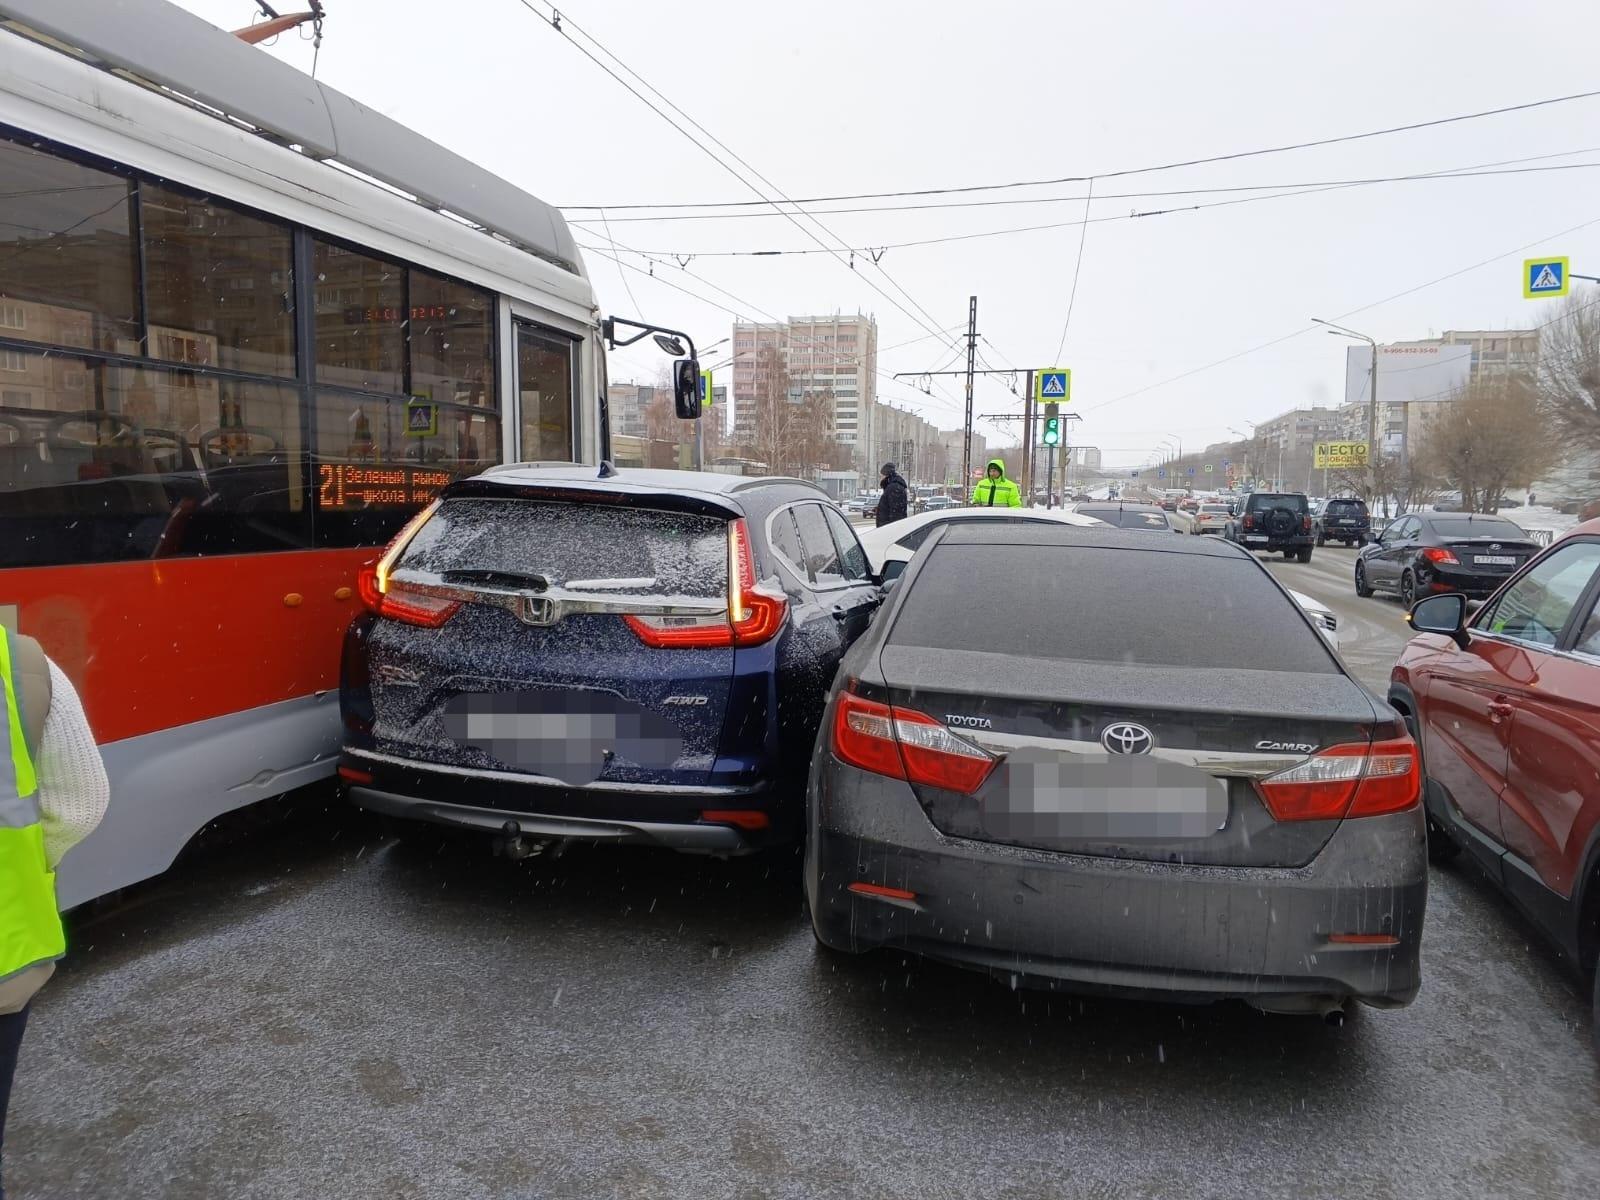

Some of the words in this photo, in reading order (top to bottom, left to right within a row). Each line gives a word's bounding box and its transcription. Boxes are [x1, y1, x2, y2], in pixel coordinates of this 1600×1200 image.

[1318, 444, 1366, 456] МЕСТО
[345, 465, 405, 484] Зеленый
[412, 472, 451, 486] рынок
[320, 464, 344, 505] 21
[663, 696, 709, 705] AWD
[945, 714, 992, 729] TOYOTA
[1256, 740, 1319, 753] CAMRY
